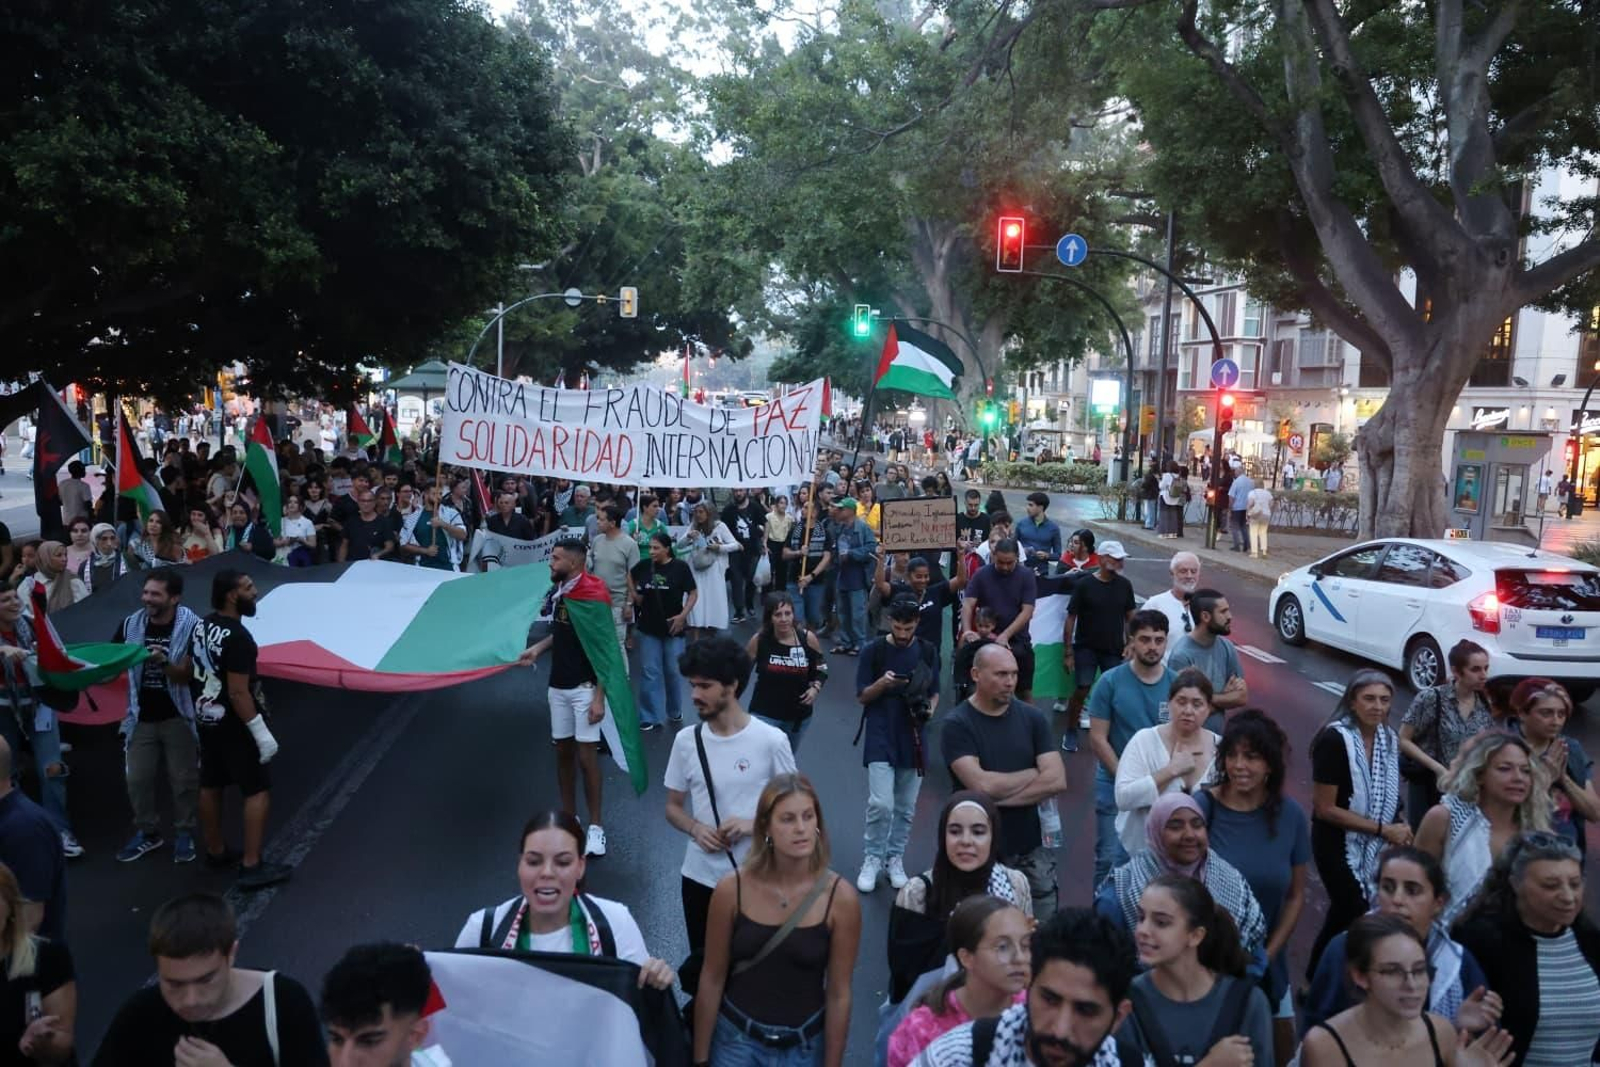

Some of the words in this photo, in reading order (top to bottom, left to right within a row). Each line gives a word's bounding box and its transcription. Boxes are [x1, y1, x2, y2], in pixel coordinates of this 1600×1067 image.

[447, 367, 527, 419] CONTRA
[540, 388, 563, 423] EL
[583, 386, 692, 430] FRAUDE
[709, 408, 737, 436] DE
[754, 386, 814, 437] PAZ
[456, 419, 634, 479] SOLIDARIDAD
[643, 429, 818, 483] INTERNACIONAL
[513, 541, 548, 550] CONTRA
